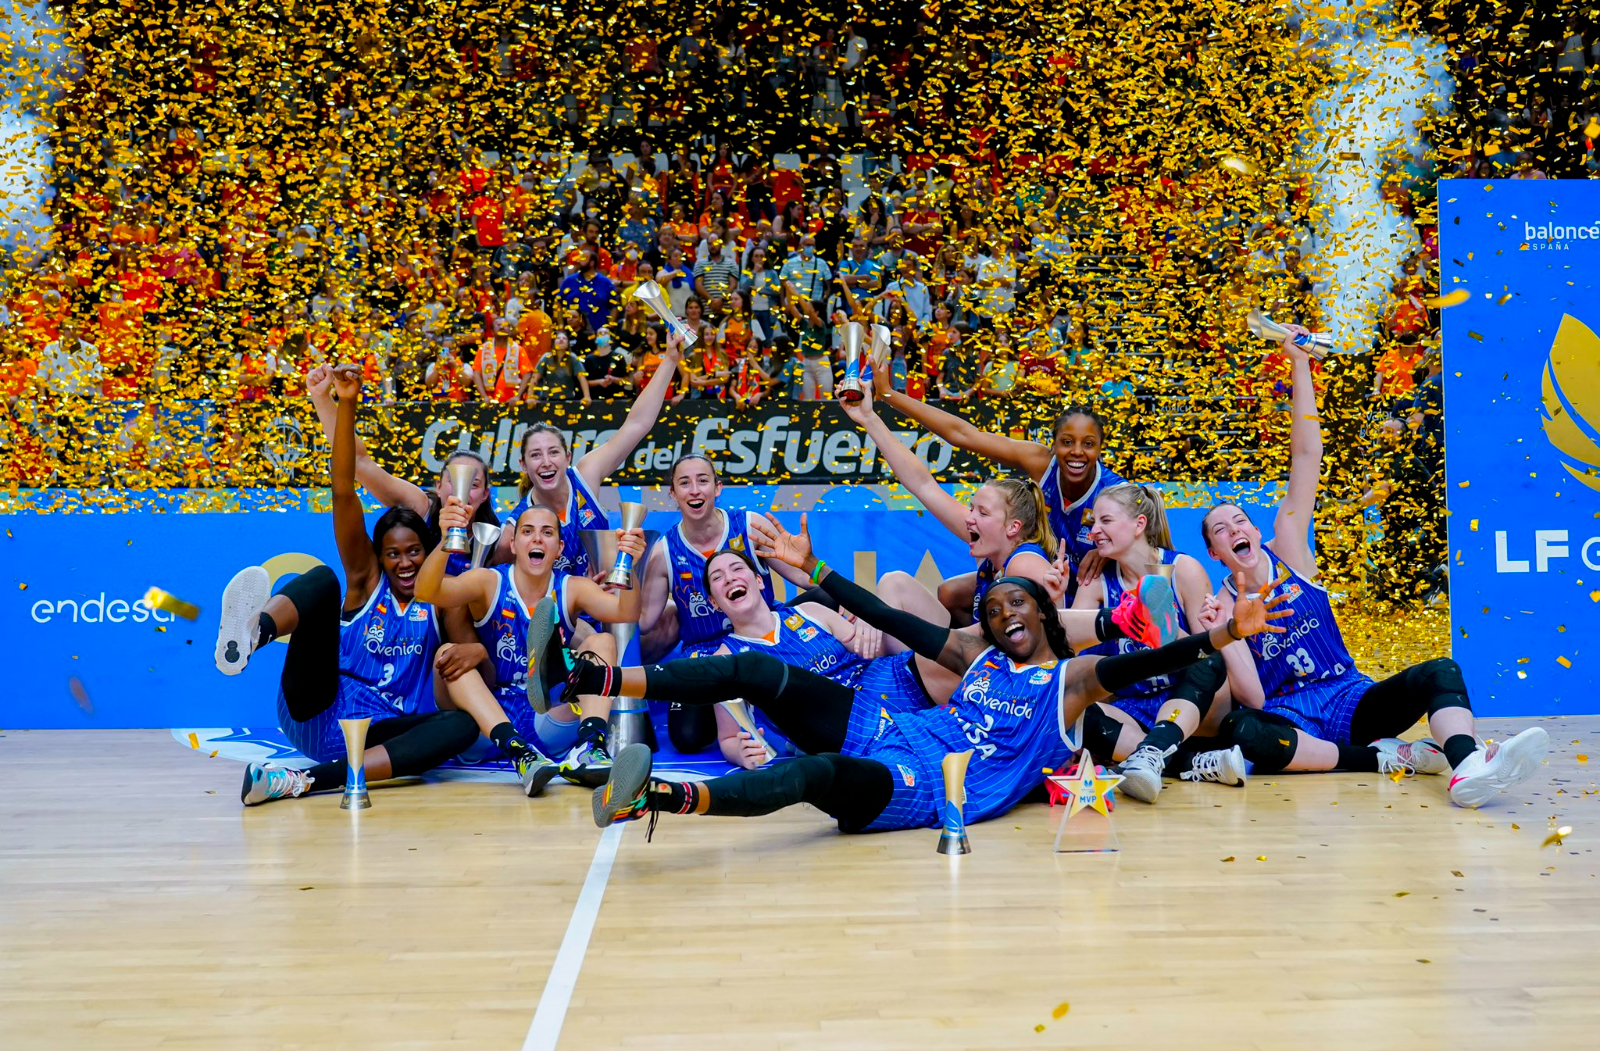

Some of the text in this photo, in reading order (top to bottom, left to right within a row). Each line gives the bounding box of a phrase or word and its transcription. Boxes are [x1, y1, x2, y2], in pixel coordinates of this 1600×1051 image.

[1519, 242, 1569, 251] SPAÑA
[634, 441, 682, 471] del
[1495, 529, 1569, 573] LF
[31, 592, 176, 623] endesa
[377, 662, 395, 687] 3
[1286, 647, 1316, 677] 33
[1080, 795, 1097, 803] MVP
